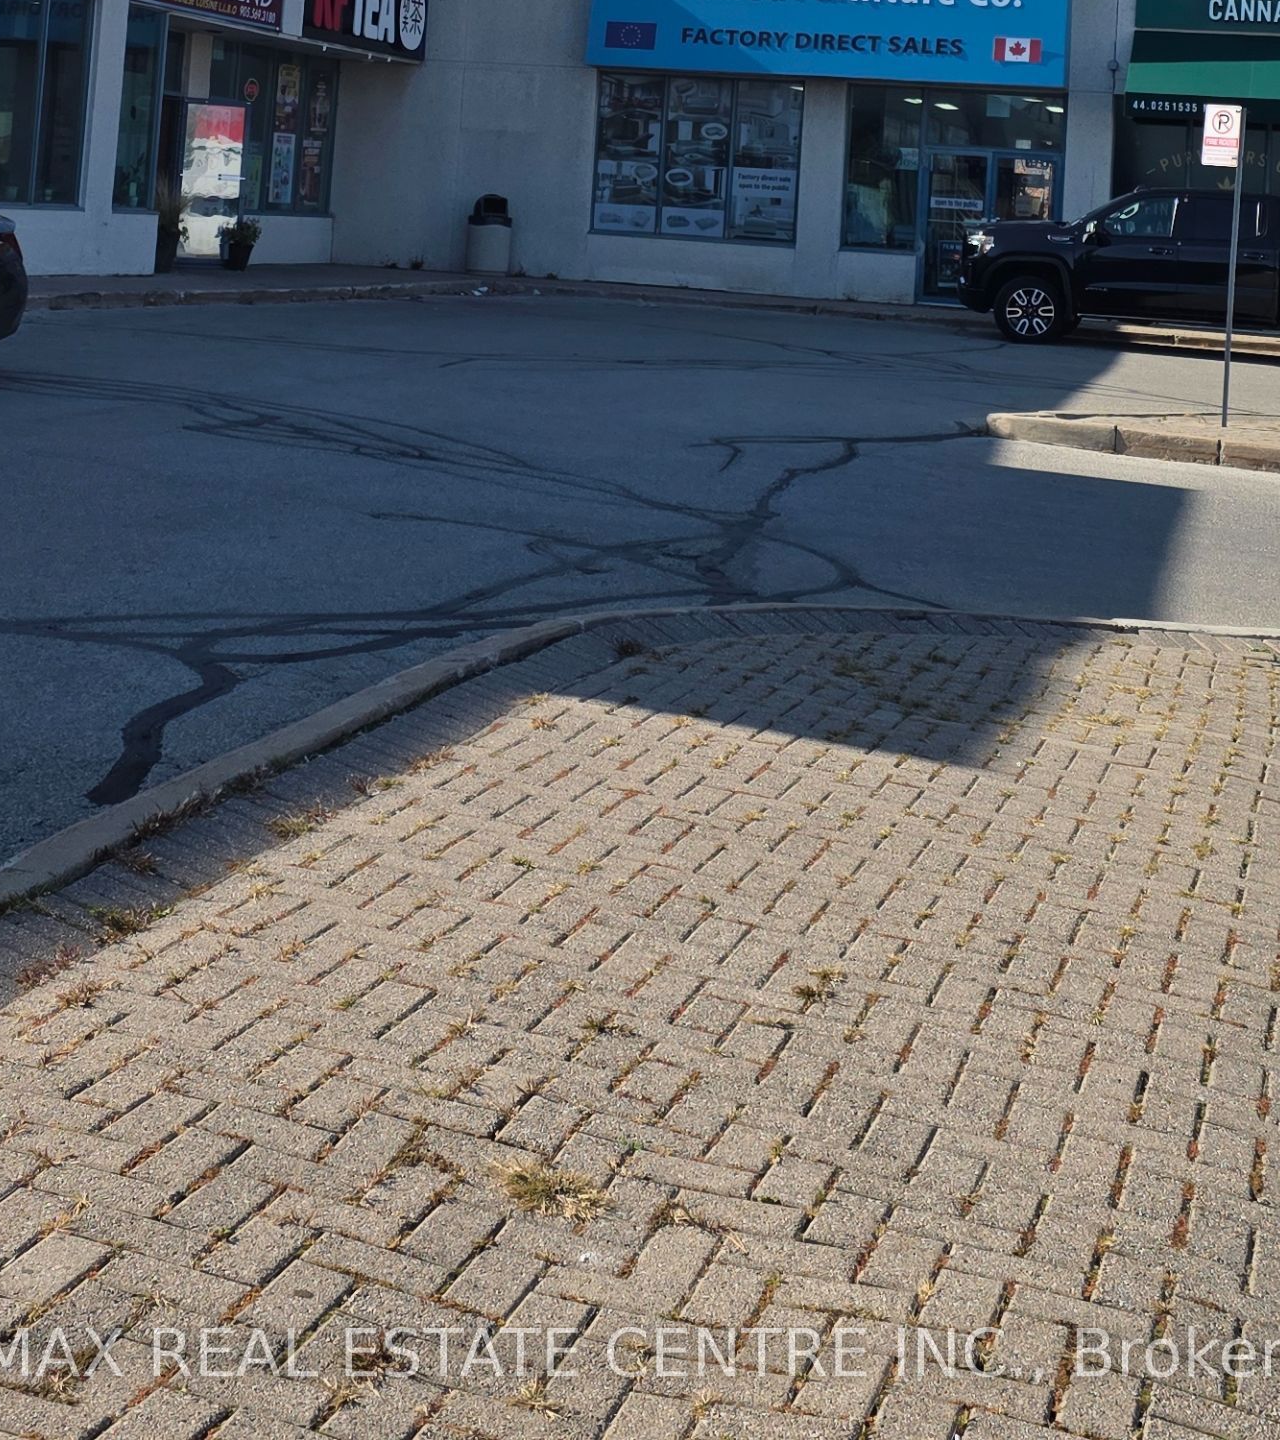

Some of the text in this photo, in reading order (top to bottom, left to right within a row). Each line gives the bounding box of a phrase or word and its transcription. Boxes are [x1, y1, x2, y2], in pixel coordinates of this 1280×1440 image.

[682, 28, 963, 56] FACTORY DIRECT SALES
[1132, 100, 1199, 113] 44.0251535
